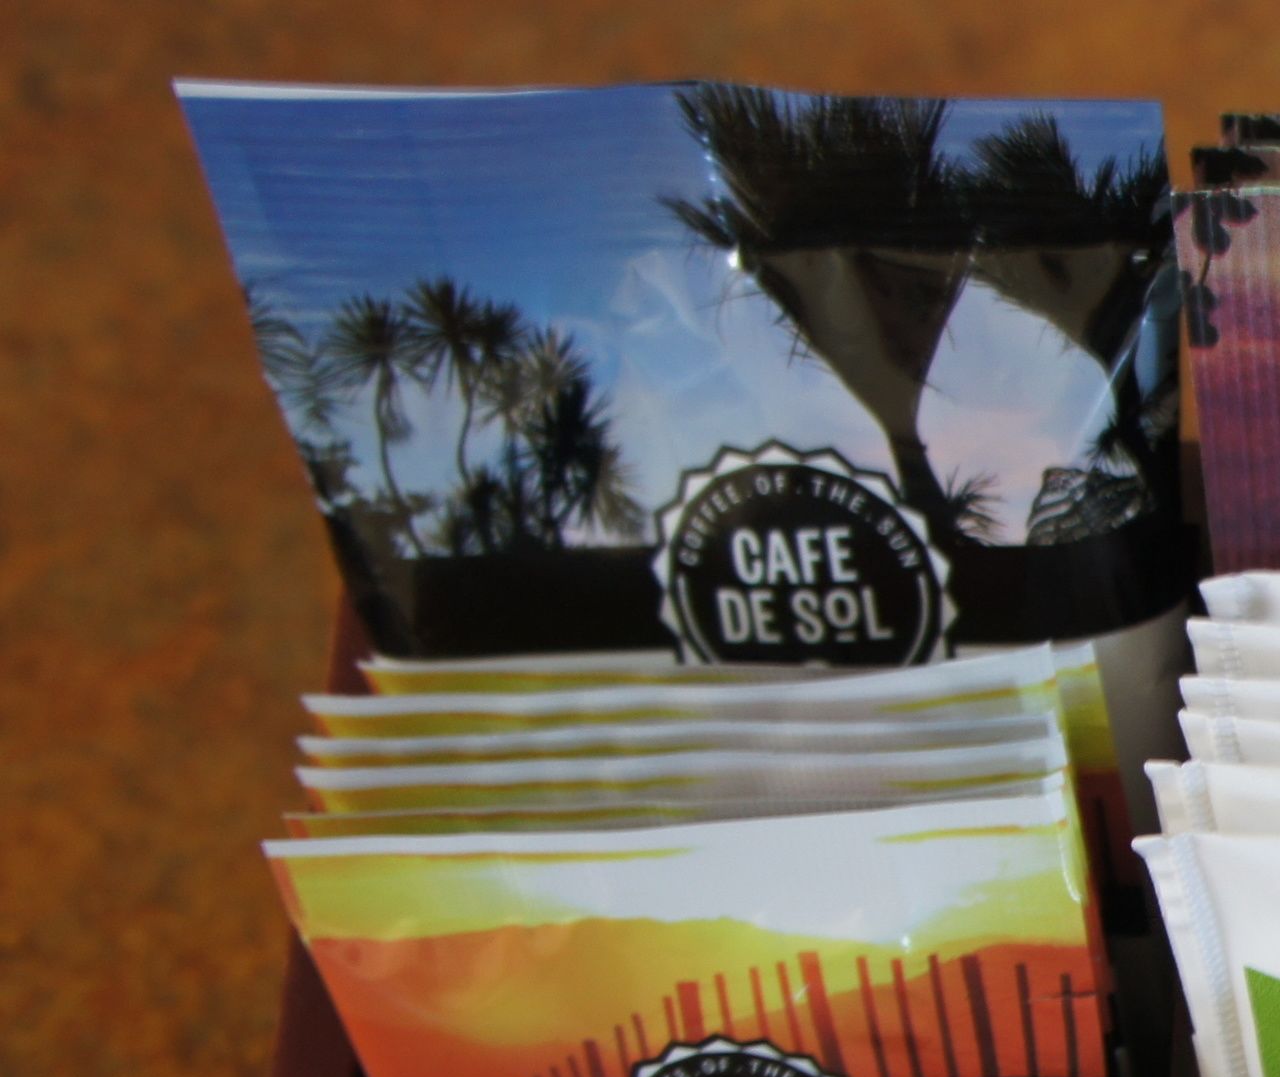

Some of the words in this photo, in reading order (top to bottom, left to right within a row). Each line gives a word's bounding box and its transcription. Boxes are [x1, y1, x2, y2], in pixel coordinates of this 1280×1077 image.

[755, 473, 785, 495] OF
[812, 477, 865, 514] THE
[877, 515, 921, 569] SUN
[731, 526, 858, 585] CAFE
[717, 587, 784, 644] DE
[703, 1058, 729, 1075] OF
